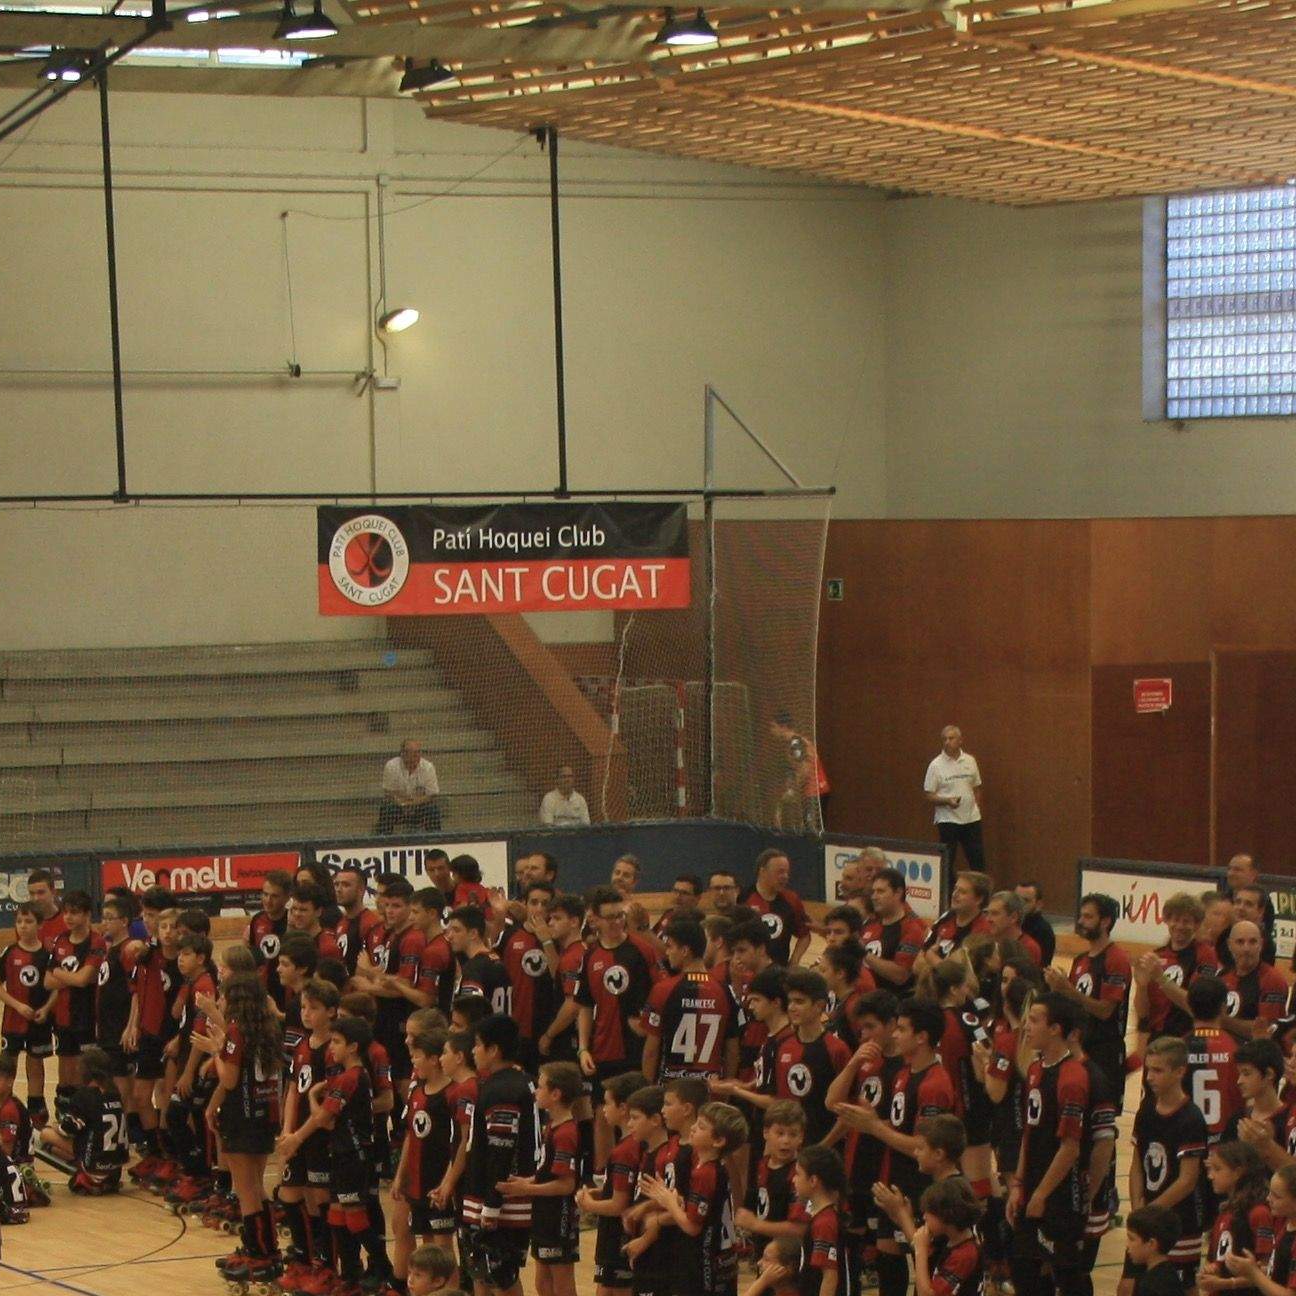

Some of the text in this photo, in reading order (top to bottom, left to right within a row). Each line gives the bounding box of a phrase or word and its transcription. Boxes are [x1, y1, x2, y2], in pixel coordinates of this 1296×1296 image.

[345, 519, 387, 536] HOQUEI
[388, 529, 405, 557] CLUB
[433, 524, 605, 552] Patí Hoquei Club
[338, 577, 399, 603] SANT CUGAT
[433, 564, 666, 604] SANT CUGAT
[671, 1013, 722, 1064] 47
[1192, 1069, 1222, 1125] 6
[102, 1114, 130, 1152] 24
